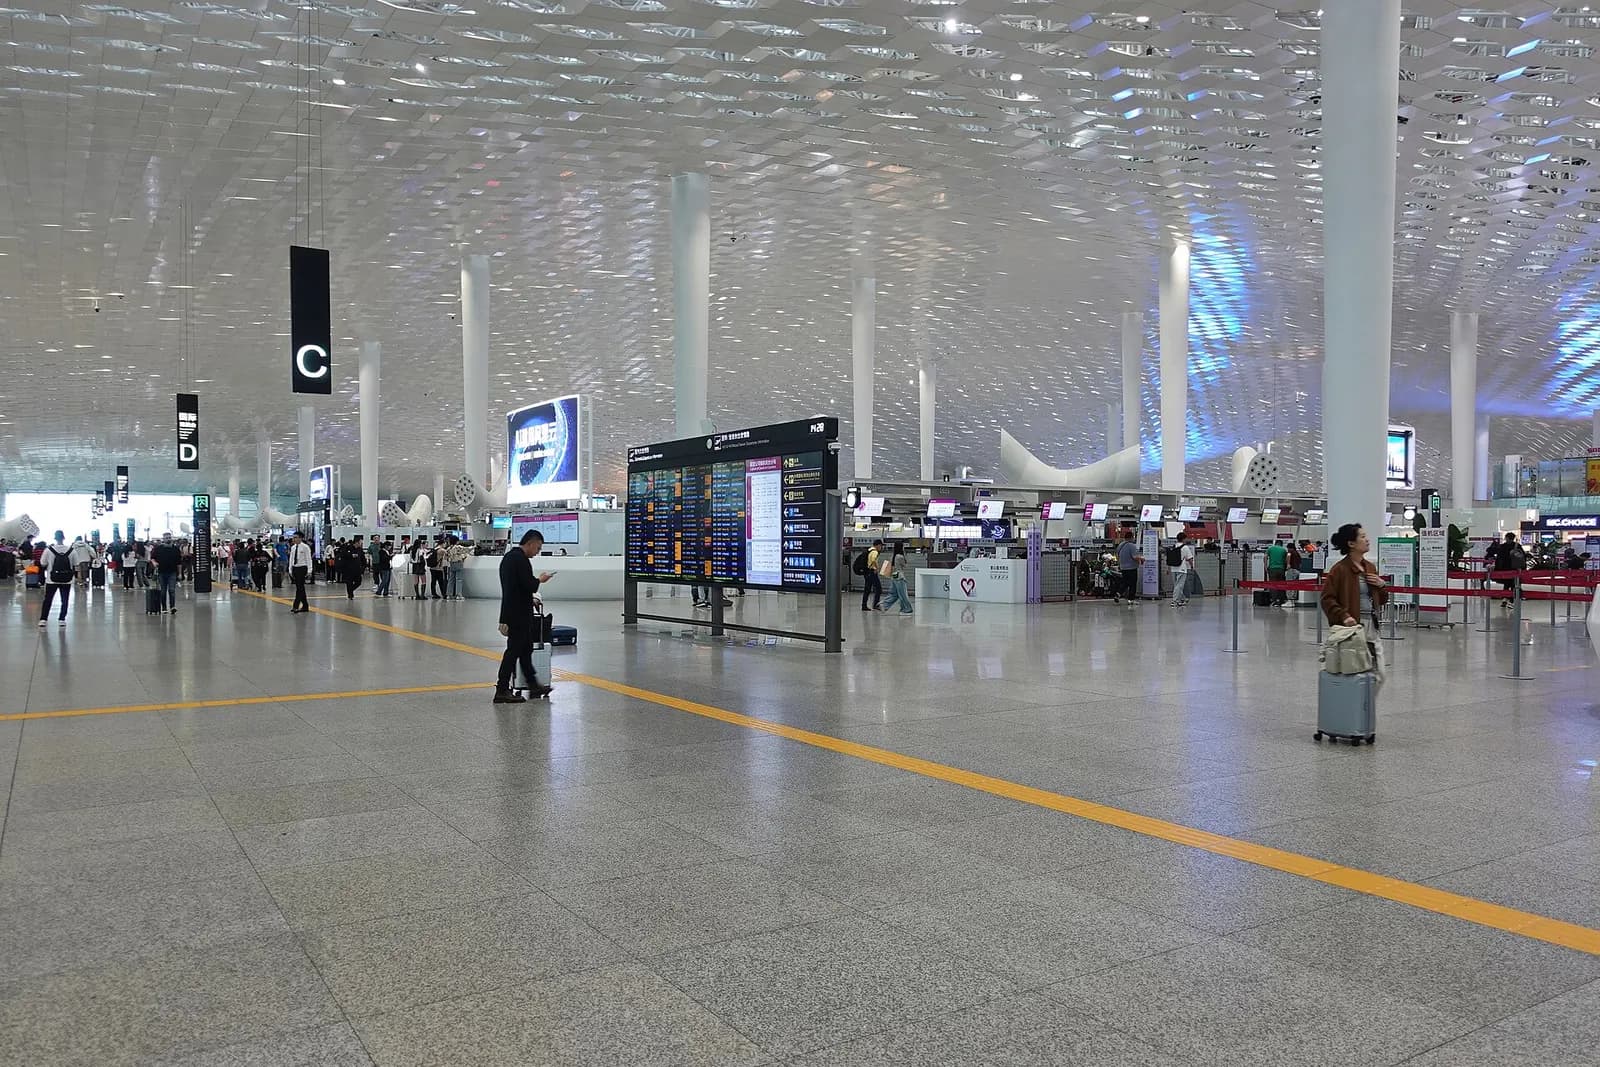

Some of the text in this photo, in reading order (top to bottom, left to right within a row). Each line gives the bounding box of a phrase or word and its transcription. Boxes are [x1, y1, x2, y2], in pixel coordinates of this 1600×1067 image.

[296, 344, 327, 379] C
[179, 443, 198, 462] D
[118, 490, 128, 501] E
